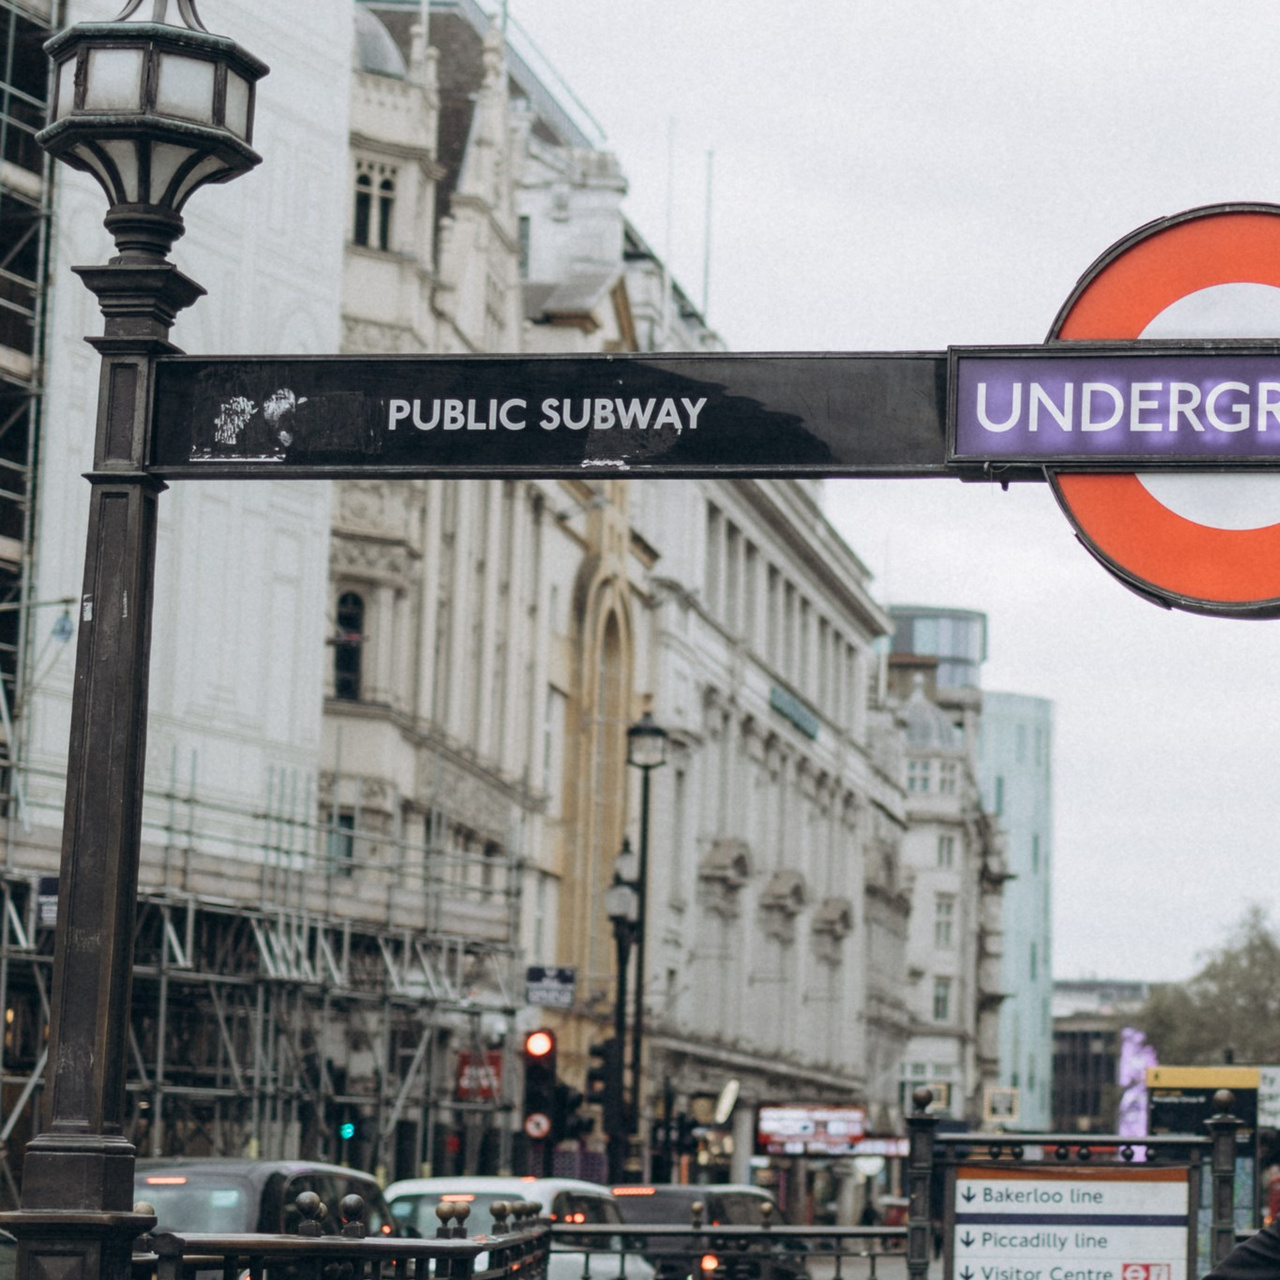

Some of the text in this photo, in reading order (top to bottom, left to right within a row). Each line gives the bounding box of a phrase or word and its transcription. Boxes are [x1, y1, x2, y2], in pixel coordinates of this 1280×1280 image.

[388, 397, 708, 431] PUBLIC SUBWAY
[982, 1187, 1103, 1204] Bakerloo line
[981, 1231, 1108, 1252] Piccadilly line
